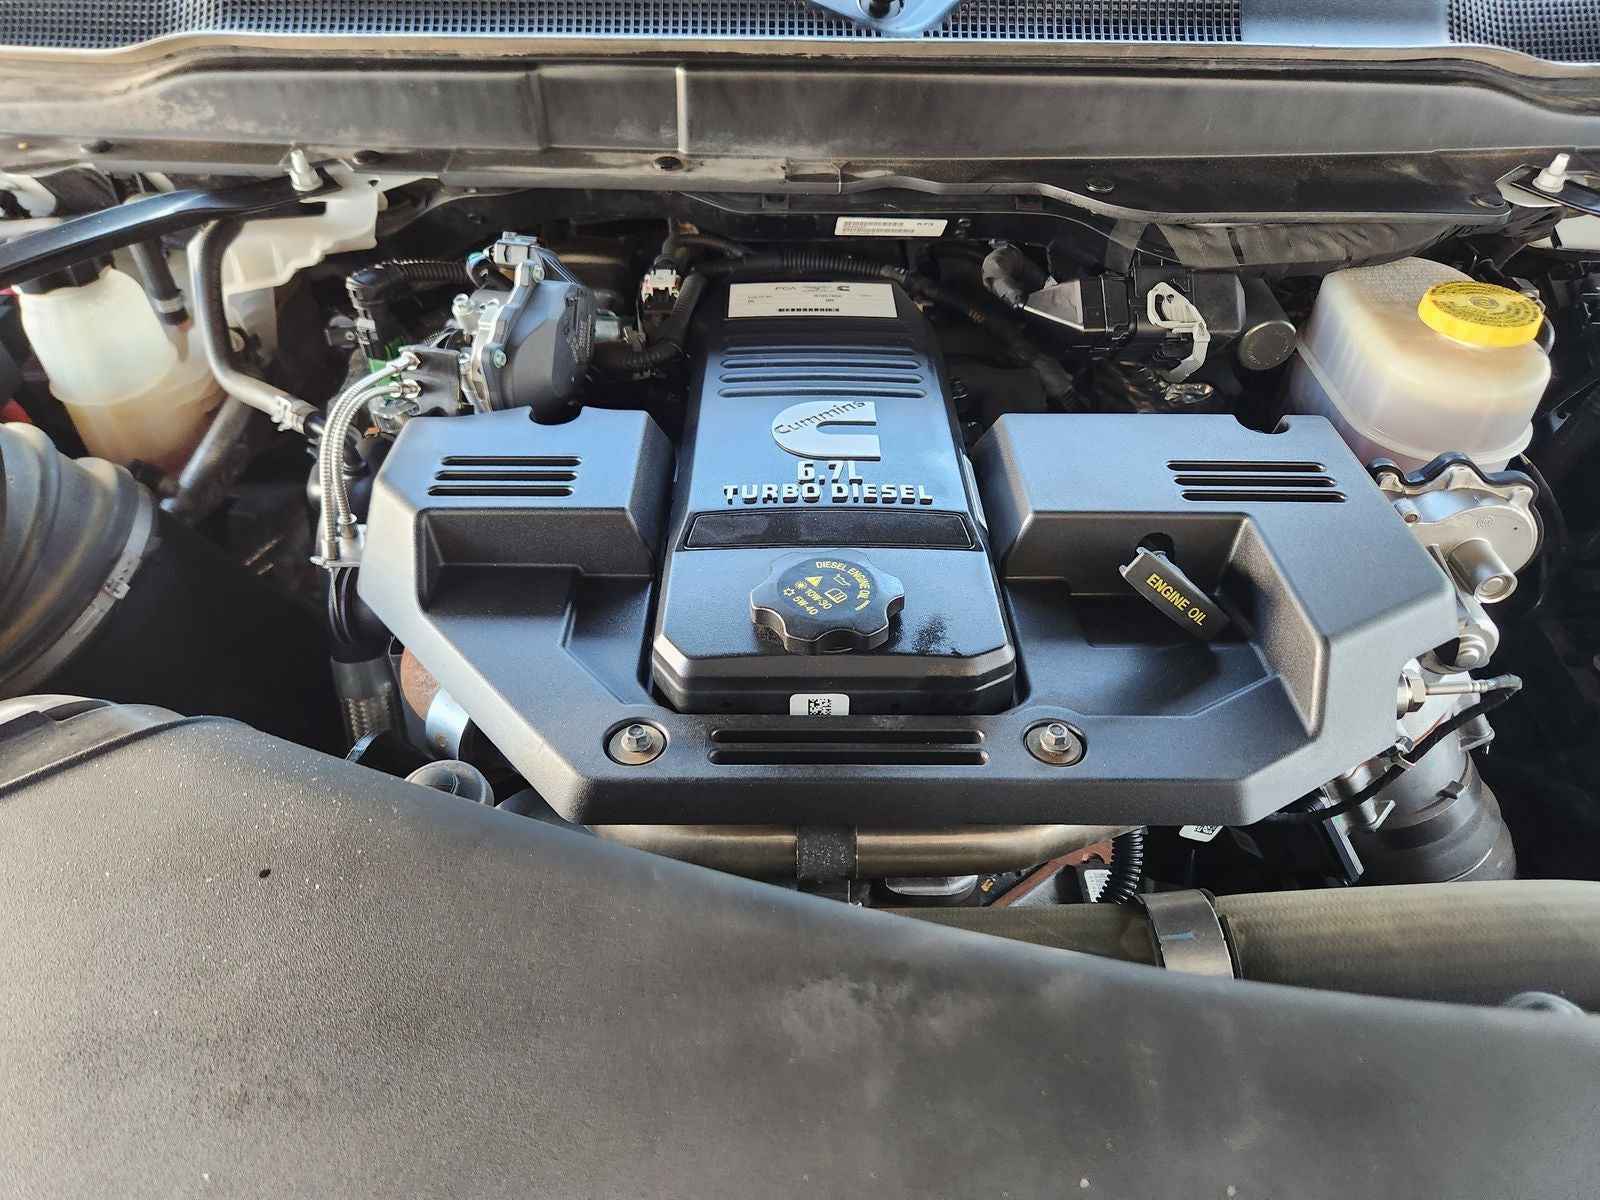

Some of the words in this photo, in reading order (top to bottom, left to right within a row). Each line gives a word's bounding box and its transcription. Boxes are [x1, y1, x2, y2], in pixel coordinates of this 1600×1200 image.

[773, 401, 866, 435] Cummins
[797, 460, 864, 485] 6.7L
[723, 483, 821, 505] TURBO
[831, 483, 934, 505] DIESEL
[815, 561, 847, 572] DIESEL
[847, 567, 870, 589] ENGINE
[793, 596, 819, 615] 5W-40
[805, 589, 832, 609] 10W-30
[1146, 573, 1190, 611] ENGINE
[1187, 607, 1207, 626] OIL
